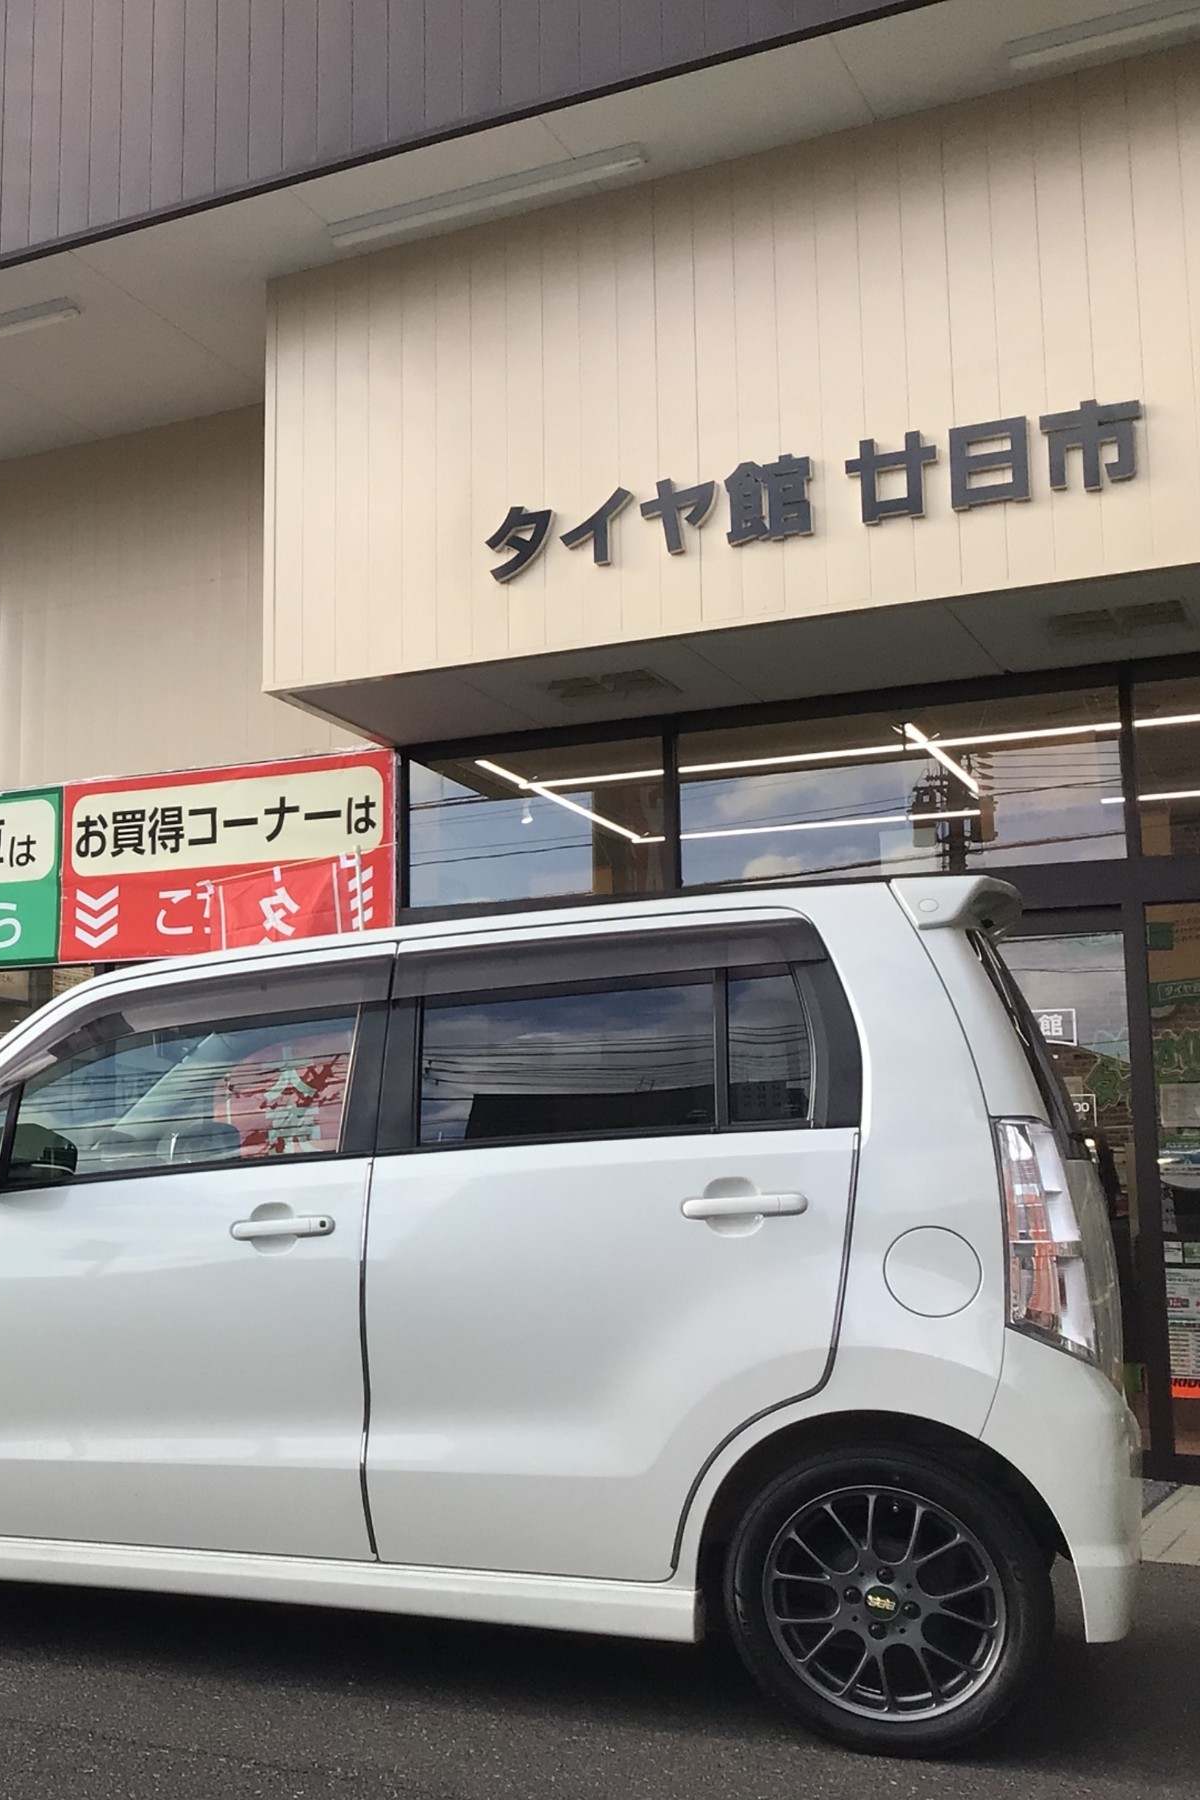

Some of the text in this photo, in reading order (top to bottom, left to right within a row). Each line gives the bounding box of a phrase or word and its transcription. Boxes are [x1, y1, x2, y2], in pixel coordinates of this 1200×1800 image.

[486, 399, 1142, 584] タイヤ館 廿日市
[76, 795, 377, 859] お買得コーナーは
